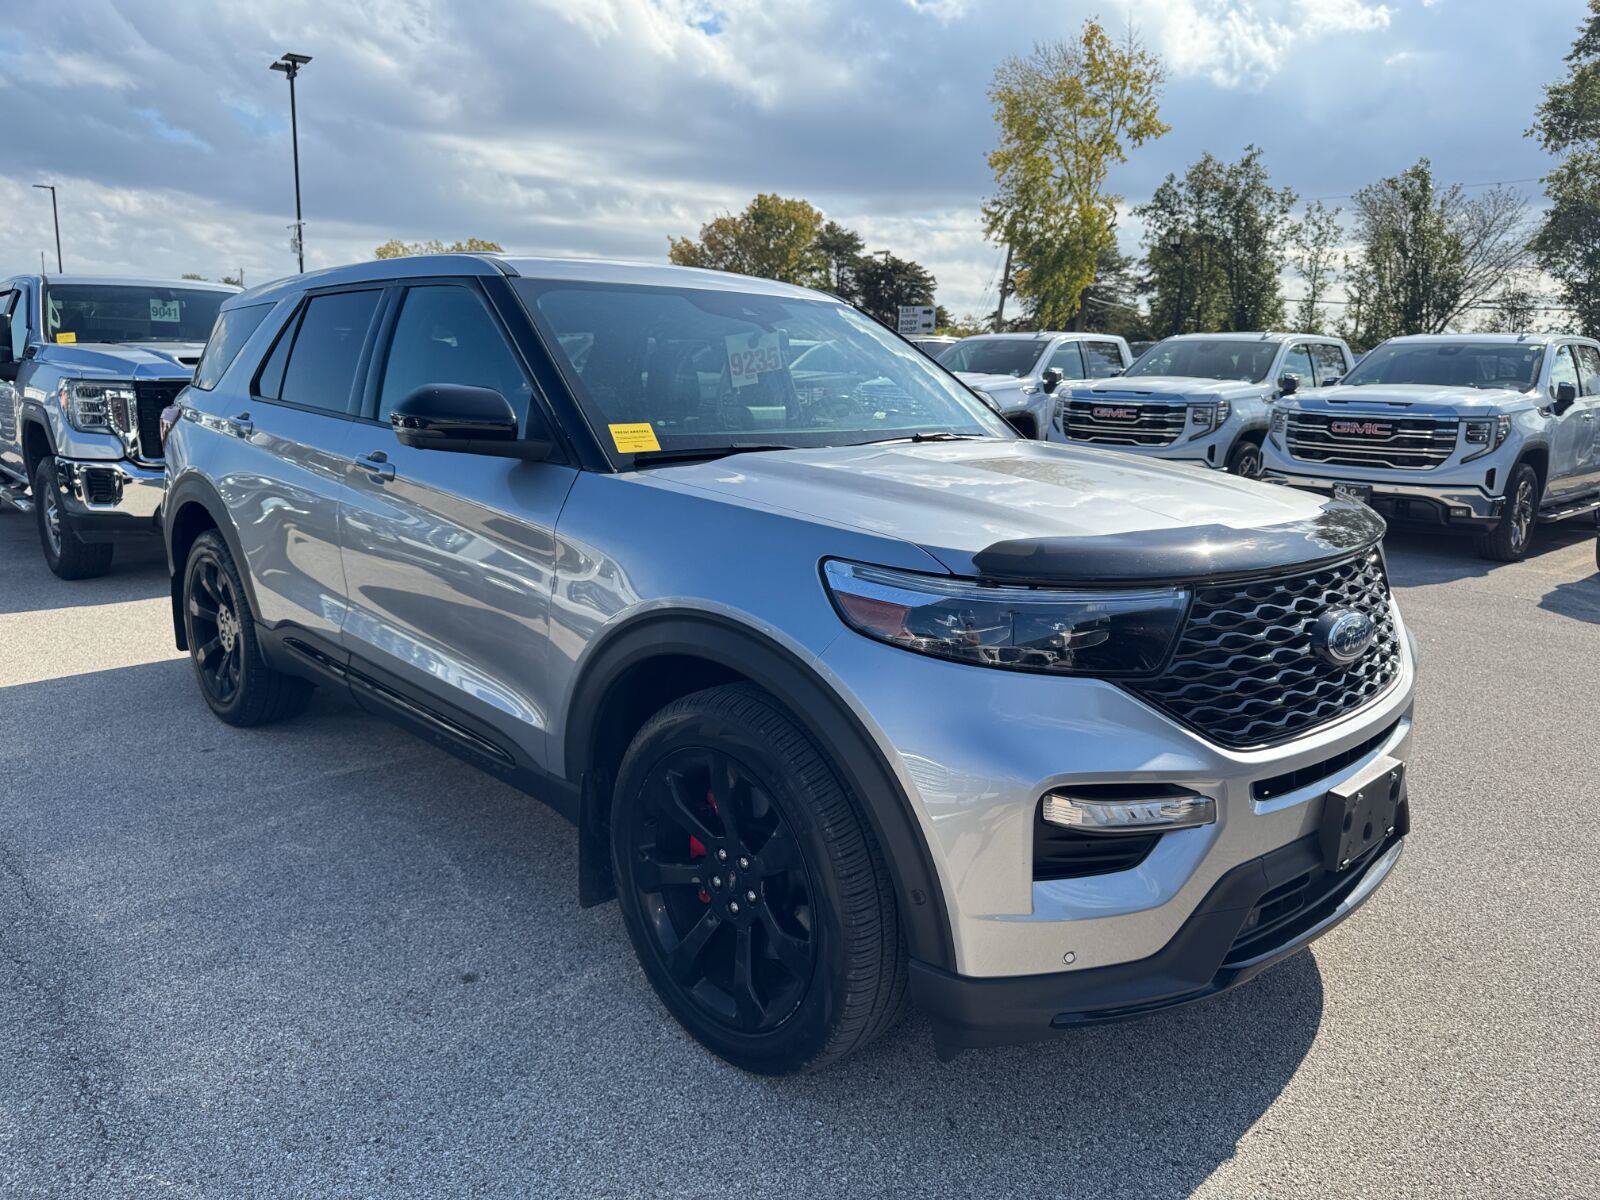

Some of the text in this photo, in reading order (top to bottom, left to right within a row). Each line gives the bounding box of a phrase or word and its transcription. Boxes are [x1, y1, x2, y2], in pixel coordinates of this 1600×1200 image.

[152, 306, 177, 318] 9041
[730, 347, 779, 376] 9235
[1092, 407, 1137, 419] GMC
[1331, 421, 1393, 436] GMC
